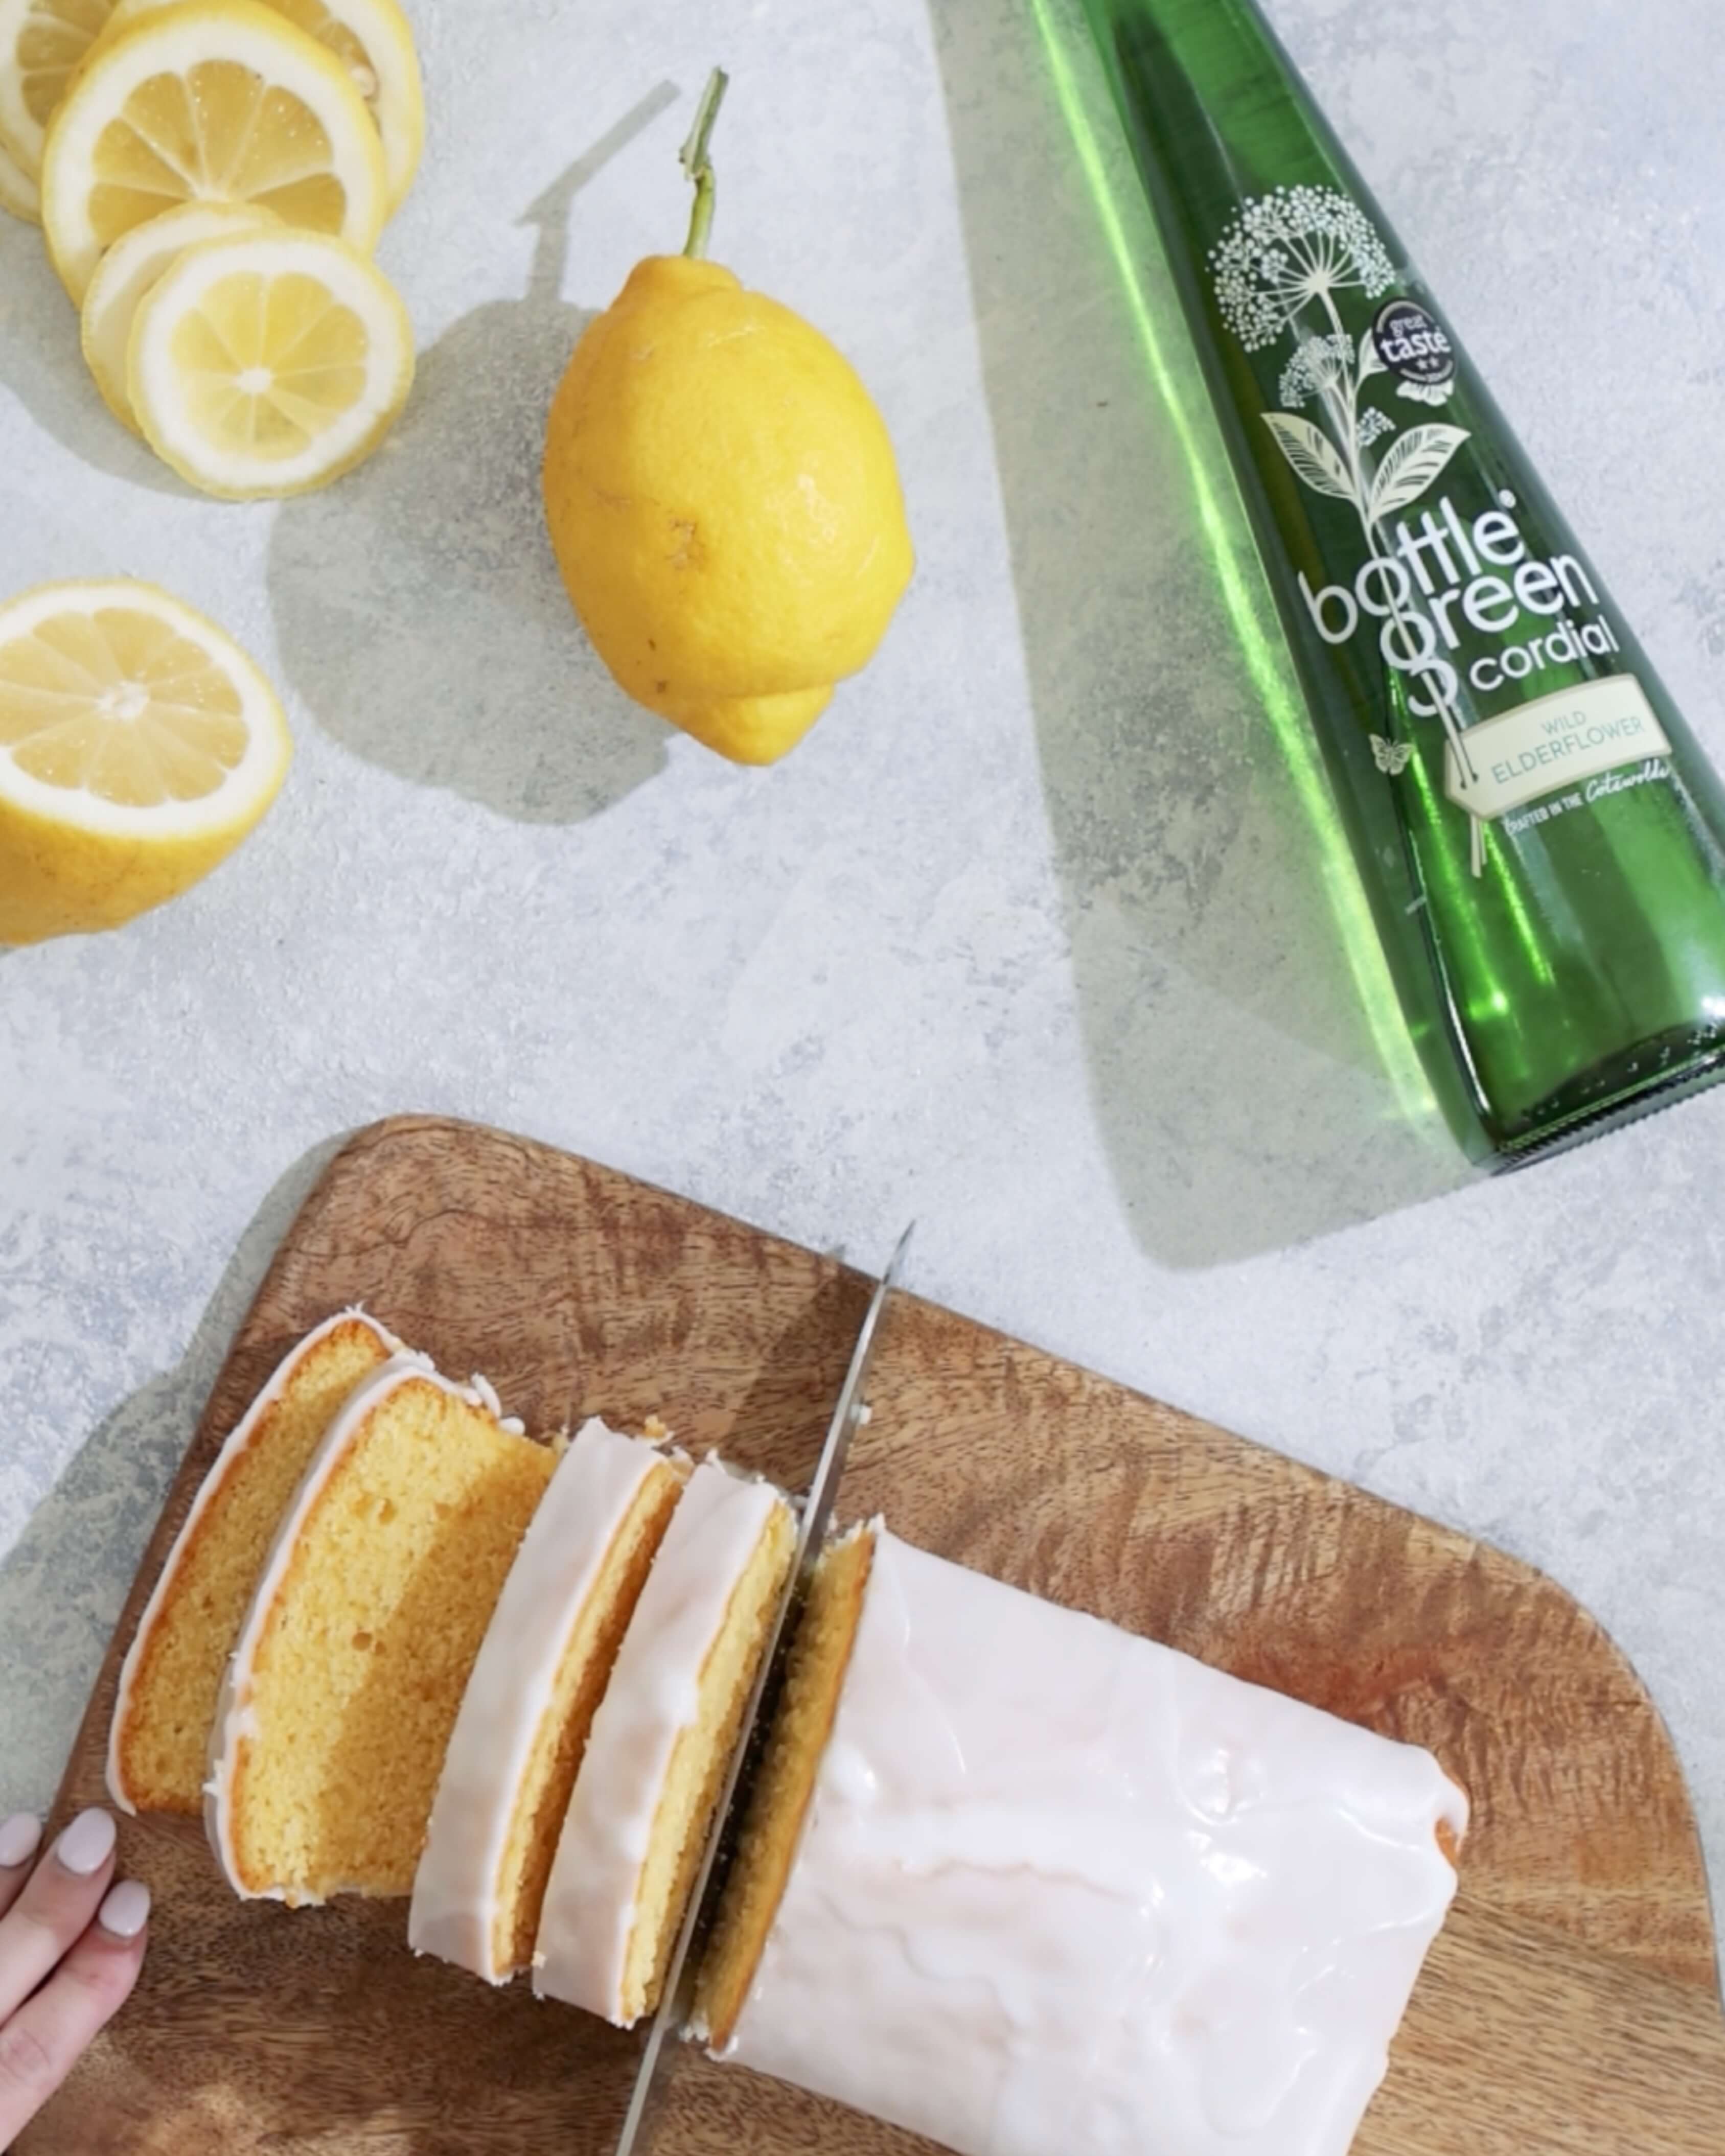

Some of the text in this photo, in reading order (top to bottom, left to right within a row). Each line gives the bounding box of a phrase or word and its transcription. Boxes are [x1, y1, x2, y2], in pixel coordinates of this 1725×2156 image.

[1298, 496, 1525, 644] bottle
[1380, 553, 1599, 717] green
[1470, 616, 1620, 691] cordial
[1490, 716, 1646, 784] ELDERFLOWER
[1540, 710, 1588, 735] WILD
[1549, 801, 1563, 817] IN
[1561, 793, 1584, 810] THE
